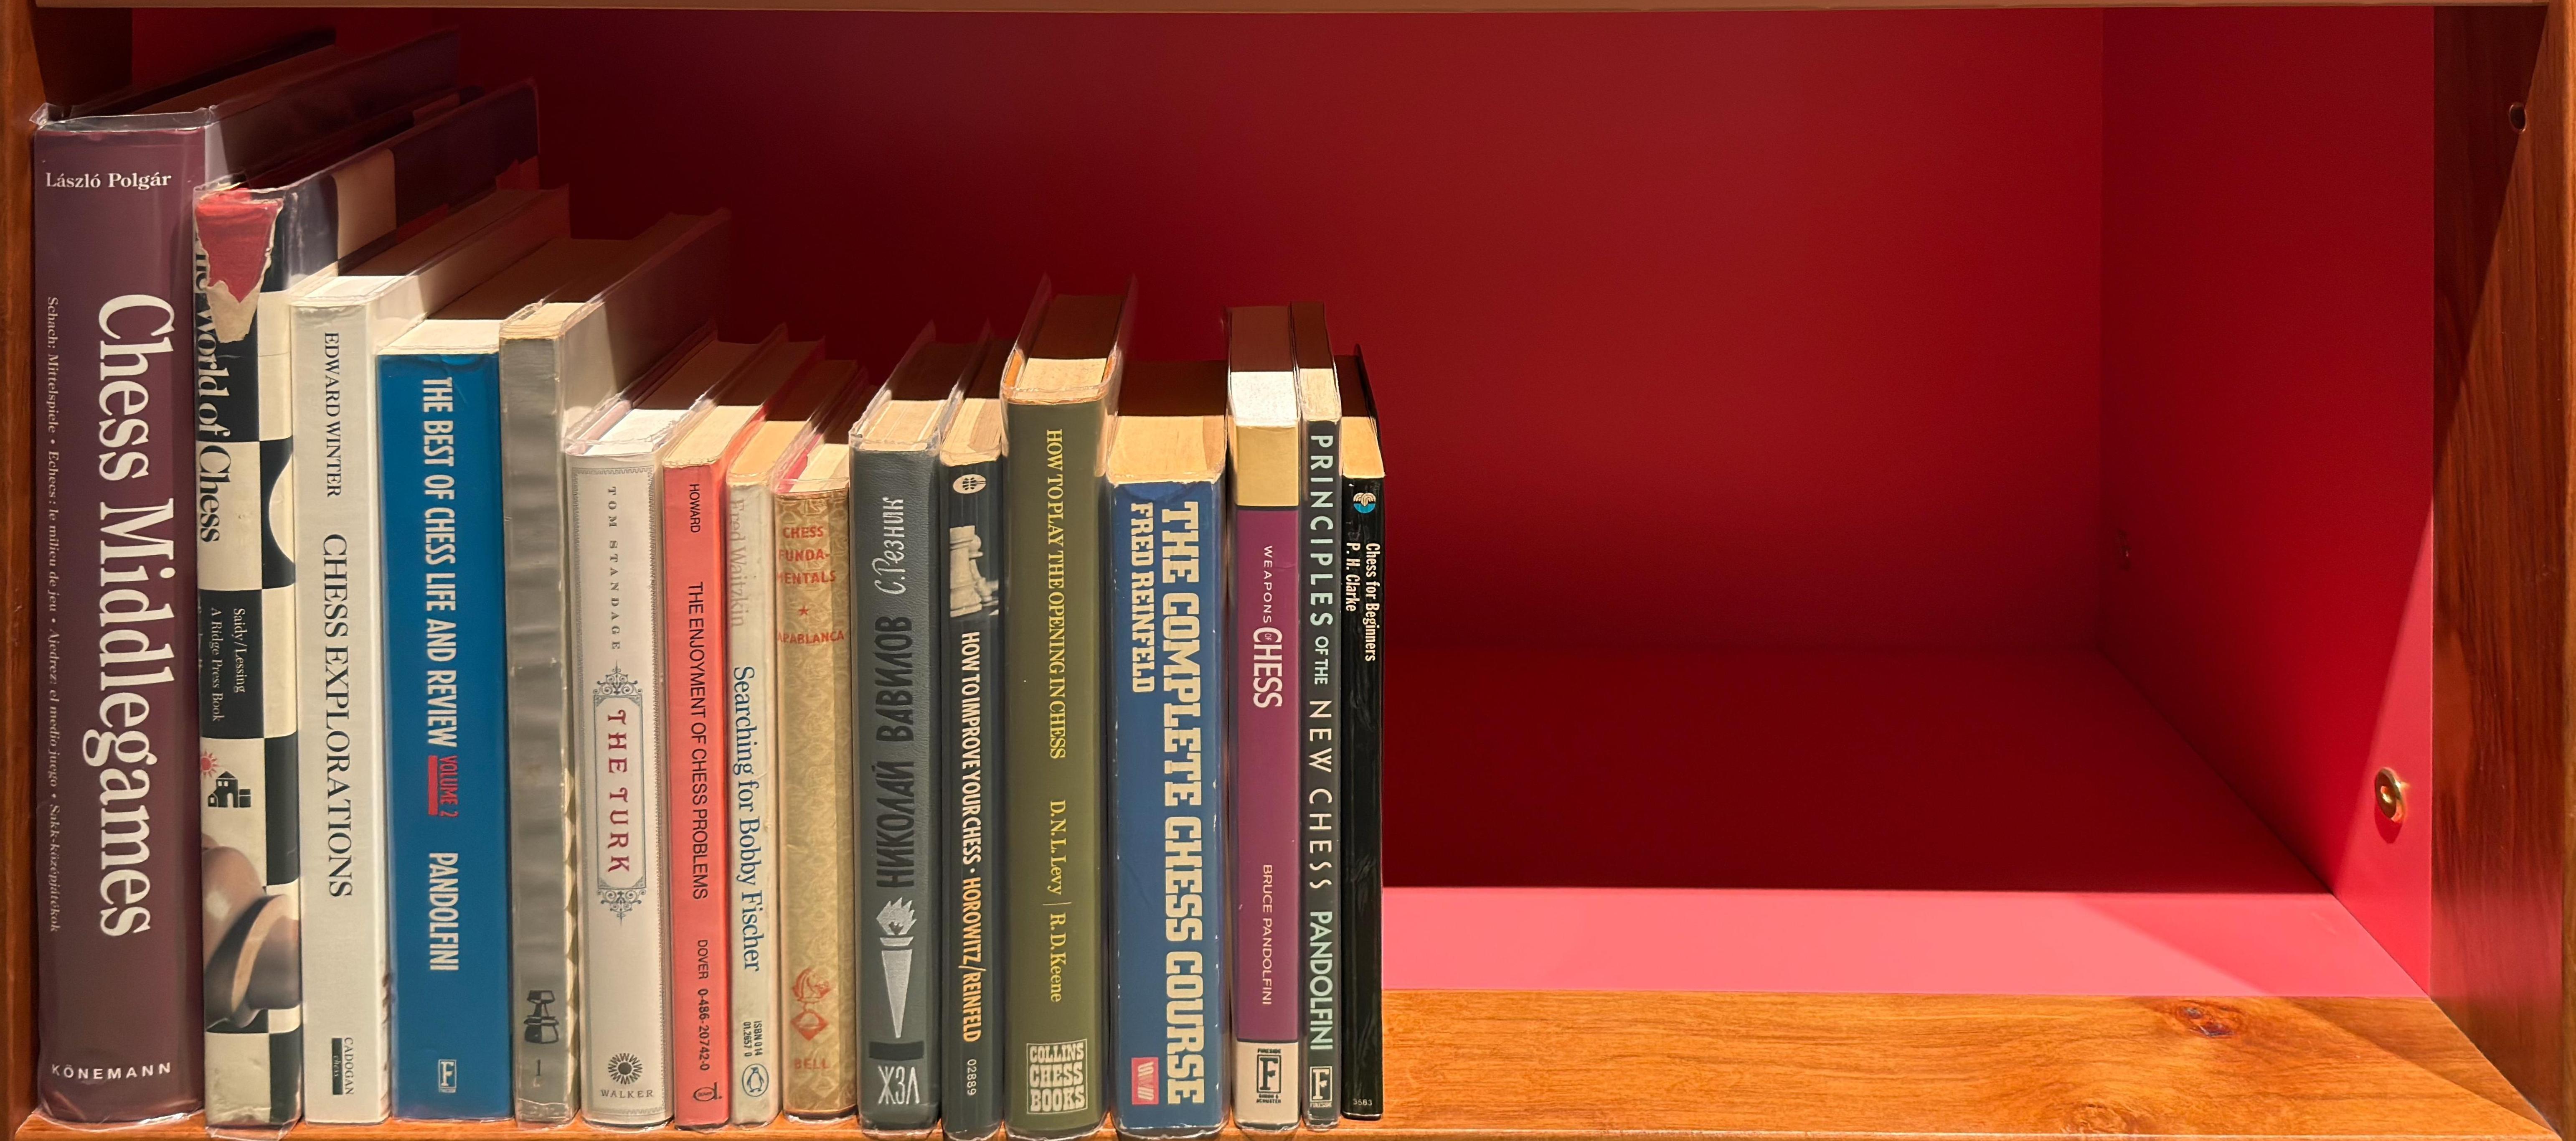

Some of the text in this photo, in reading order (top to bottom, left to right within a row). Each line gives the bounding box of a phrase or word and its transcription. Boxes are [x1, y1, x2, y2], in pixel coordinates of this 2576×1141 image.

[45, 171, 172, 190] László Polgár
[196, 308, 229, 397] World
[46, 355, 58, 433] Mittelspiele
[324, 332, 342, 497] EDWARD WINTER
[198, 402, 230, 437] of
[48, 509, 58, 521] le
[199, 445, 231, 542] Chess
[689, 483, 700, 533] HOWARD
[48, 525, 58, 566] milieu
[778, 548, 830, 562] FUNDA-
[782, 526, 824, 539] CHESS
[48, 571, 58, 586] de
[422, 376, 457, 747] THE BEST OF CHESS LIFE AND REVIEW
[607, 486, 621, 650] TOM STANDAGE
[1345, 542, 1361, 612] P. H. Clarke
[47, 589, 60, 611] jeu
[83, 294, 175, 938] Chess Middlegames
[1046, 429, 1066, 759] HOW TO PLAY THE OPENING IN CHESS
[1130, 502, 1155, 693] FRED REINFELD
[1363, 543, 1381, 662] Chess for Beginners
[231, 608, 247, 693] Saidy/Lessing
[778, 630, 845, 644] APABLANCA
[961, 631, 980, 671] HOW
[1253, 545, 1283, 708] WEAPONS OF CHESS
[209, 607, 225, 722] A Ridge Press Book
[961, 673, 980, 696] TO
[48, 689, 60, 702] el
[323, 534, 353, 897] CHESS EXPLORATIONS
[48, 706, 59, 747] medio
[688, 582, 708, 900] THE ENJOYMENT OF CHESS PROBLEMS
[961, 697, 981, 769] IMPROVE
[1309, 435, 1334, 1050] PRINCIPLES OF THE NEW CHESS PANDOLFINI
[46, 749, 59, 788] juego
[871, 616, 915, 888] НИКОЛАЙ ВАВИЛОВ
[439, 755, 458, 805] VOLUME
[607, 709, 629, 873] THE TURK
[962, 770, 981, 815] YOUR
[1162, 501, 1204, 1104] THE COMPLETE CHESS COURSE
[732, 666, 764, 972] Searching for Bobby Fischer
[962, 817, 982, 865] CHESS
[1047, 856, 1066, 895] Levy
[429, 853, 459, 971] PANDOLFINI
[1262, 864, 1273, 1005] BRUCE PANDOLFINI
[1050, 912, 1067, 1002] R. D. Keene
[698, 940, 710, 1071] DOVER 0-486-20742-0
[754, 1020, 762, 1040] ISBN
[51, 1062, 171, 1080] KÖNEMANN
[344, 1037, 354, 1095] CADOGAN
[794, 1057, 830, 1070] BELL
[1029, 1042, 1084, 1062] COLLINS
[1029, 1062, 1084, 1087] CHESS
[600, 1088, 654, 1098] WALKER
[878, 1065, 920, 1105] ЖЗЛ
[967, 1059, 977, 1097] 02889
[1030, 1086, 1085, 1112] BOOKS
